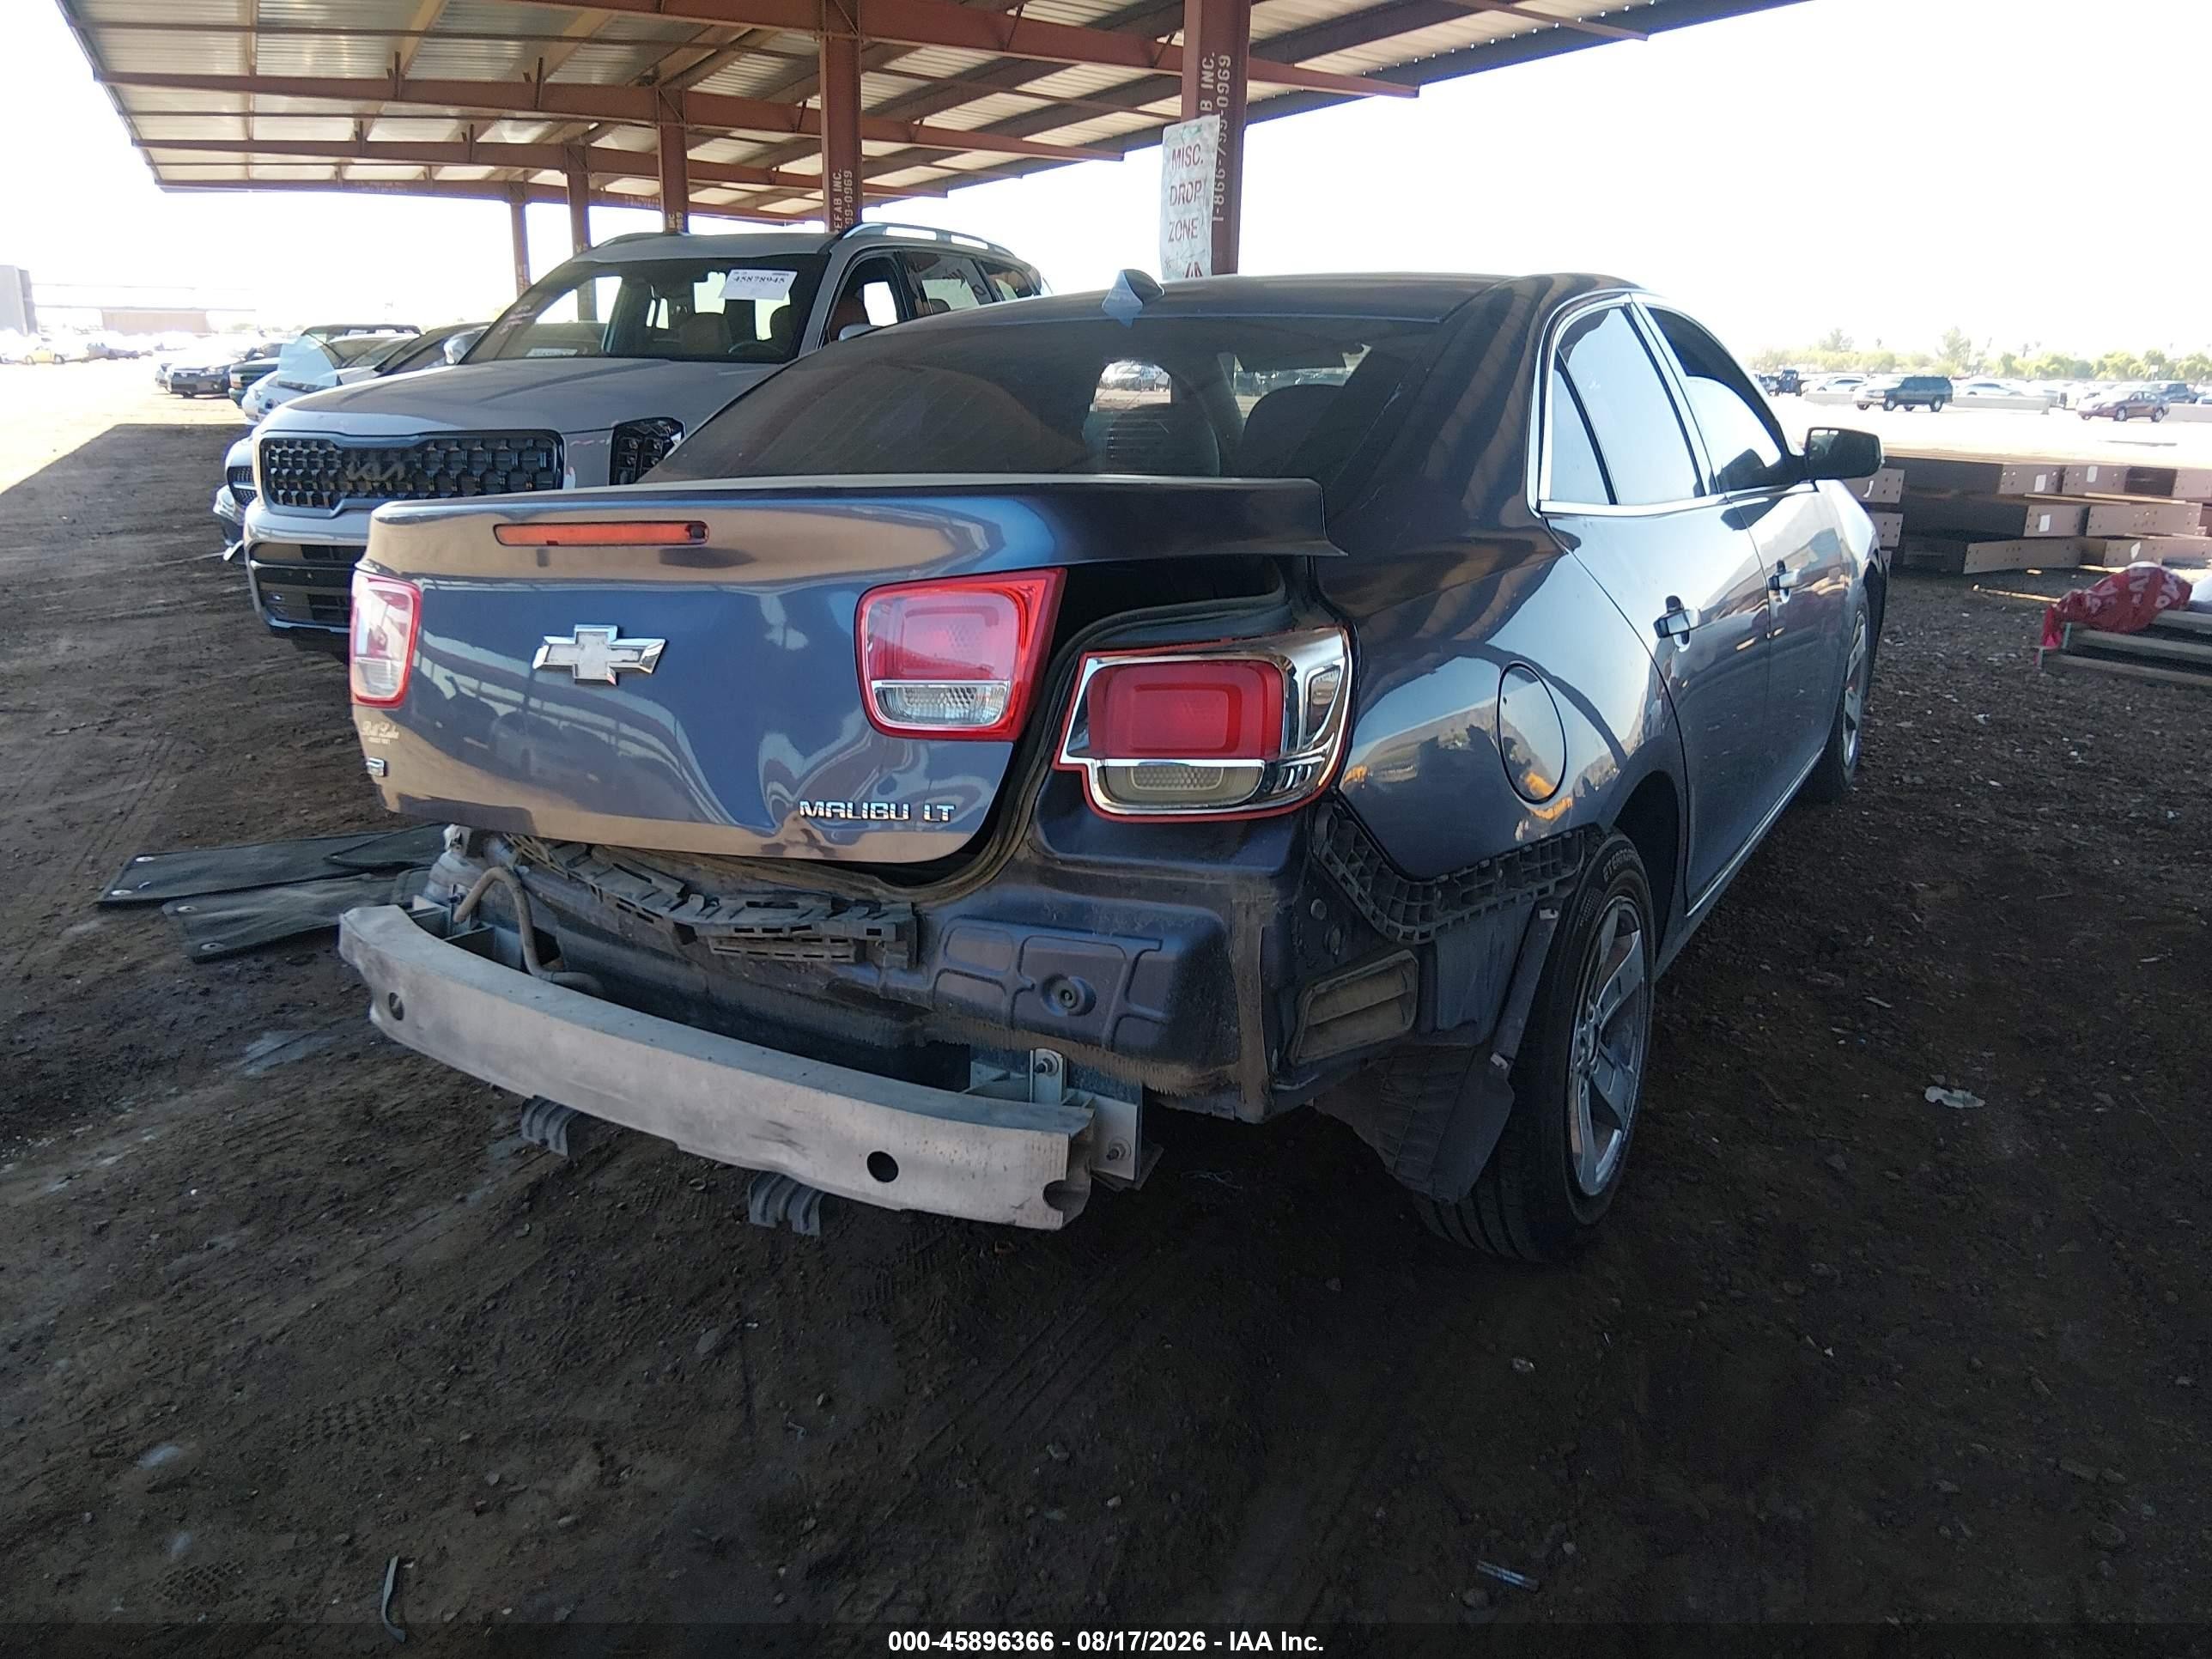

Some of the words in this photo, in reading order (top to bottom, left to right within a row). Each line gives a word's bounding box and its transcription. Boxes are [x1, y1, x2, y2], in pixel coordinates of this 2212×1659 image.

[1200, 52, 1215, 89] INC.
[1171, 143, 1204, 170] MISC.
[832, 168, 842, 192] INC.
[1170, 179, 1202, 206] DROP
[843, 170, 854, 228] 99-0969
[1168, 217, 1199, 242] ZONE
[799, 800, 910, 821] MALIBU
[923, 803, 956, 822] LT
